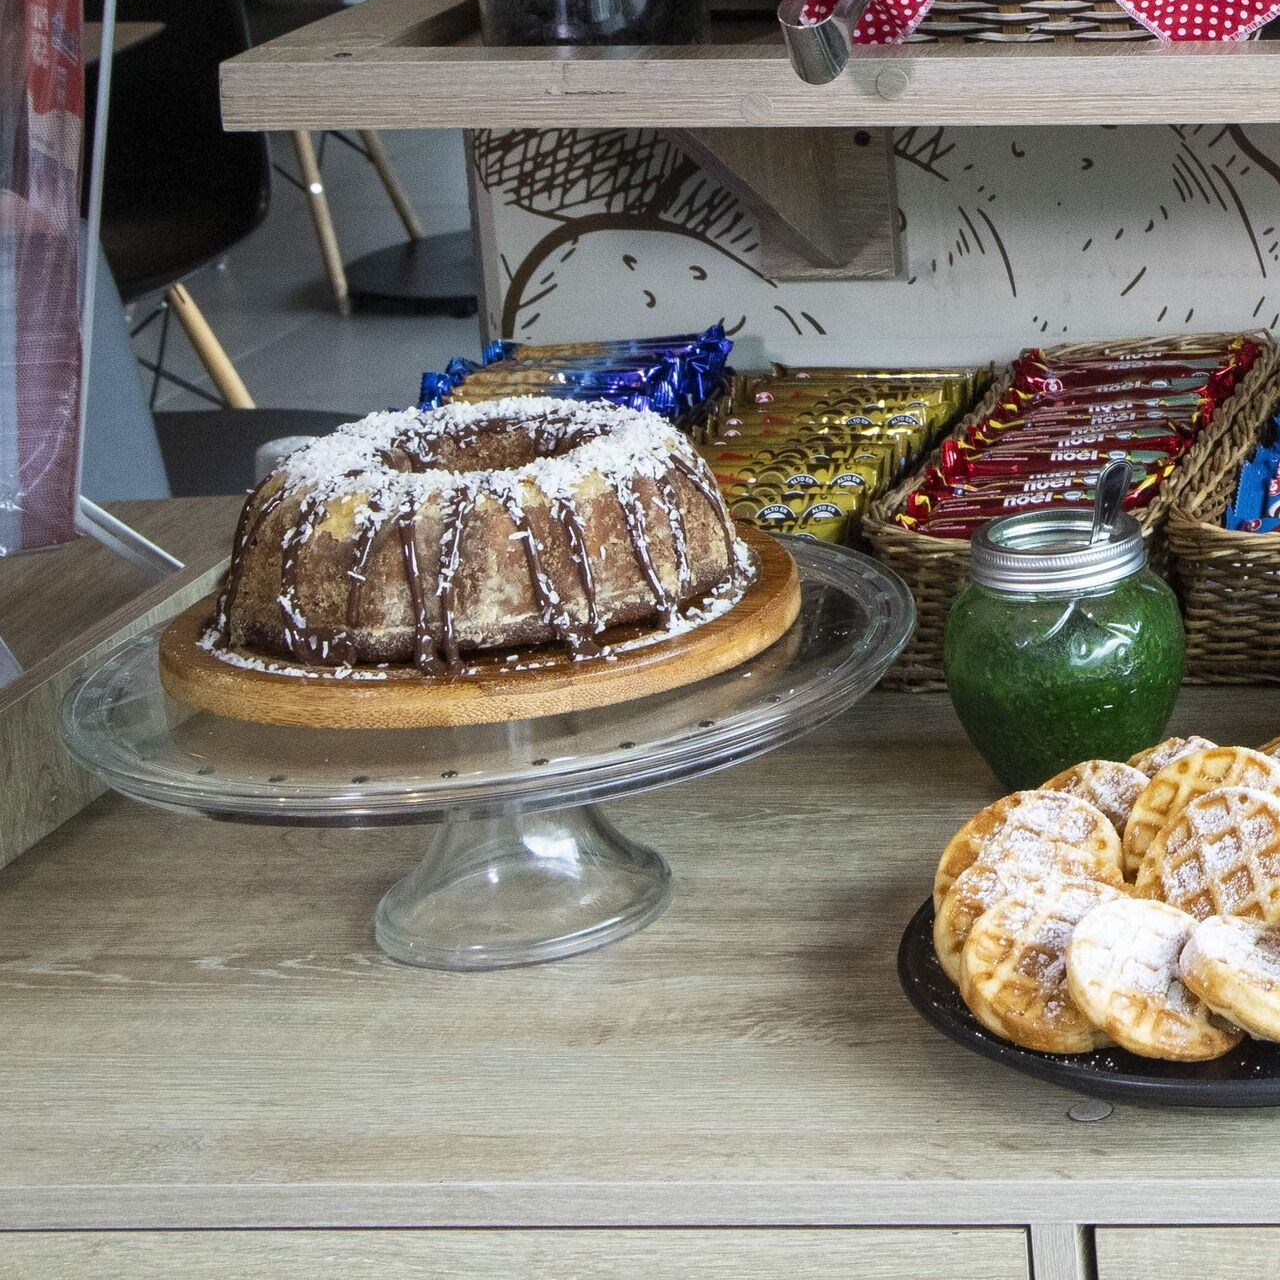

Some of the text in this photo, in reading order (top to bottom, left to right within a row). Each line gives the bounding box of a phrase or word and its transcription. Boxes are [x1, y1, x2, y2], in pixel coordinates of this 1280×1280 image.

[1050, 450, 1098, 461] noel
[1023, 478, 1073, 492] noel
[1003, 491, 1054, 507] noel
